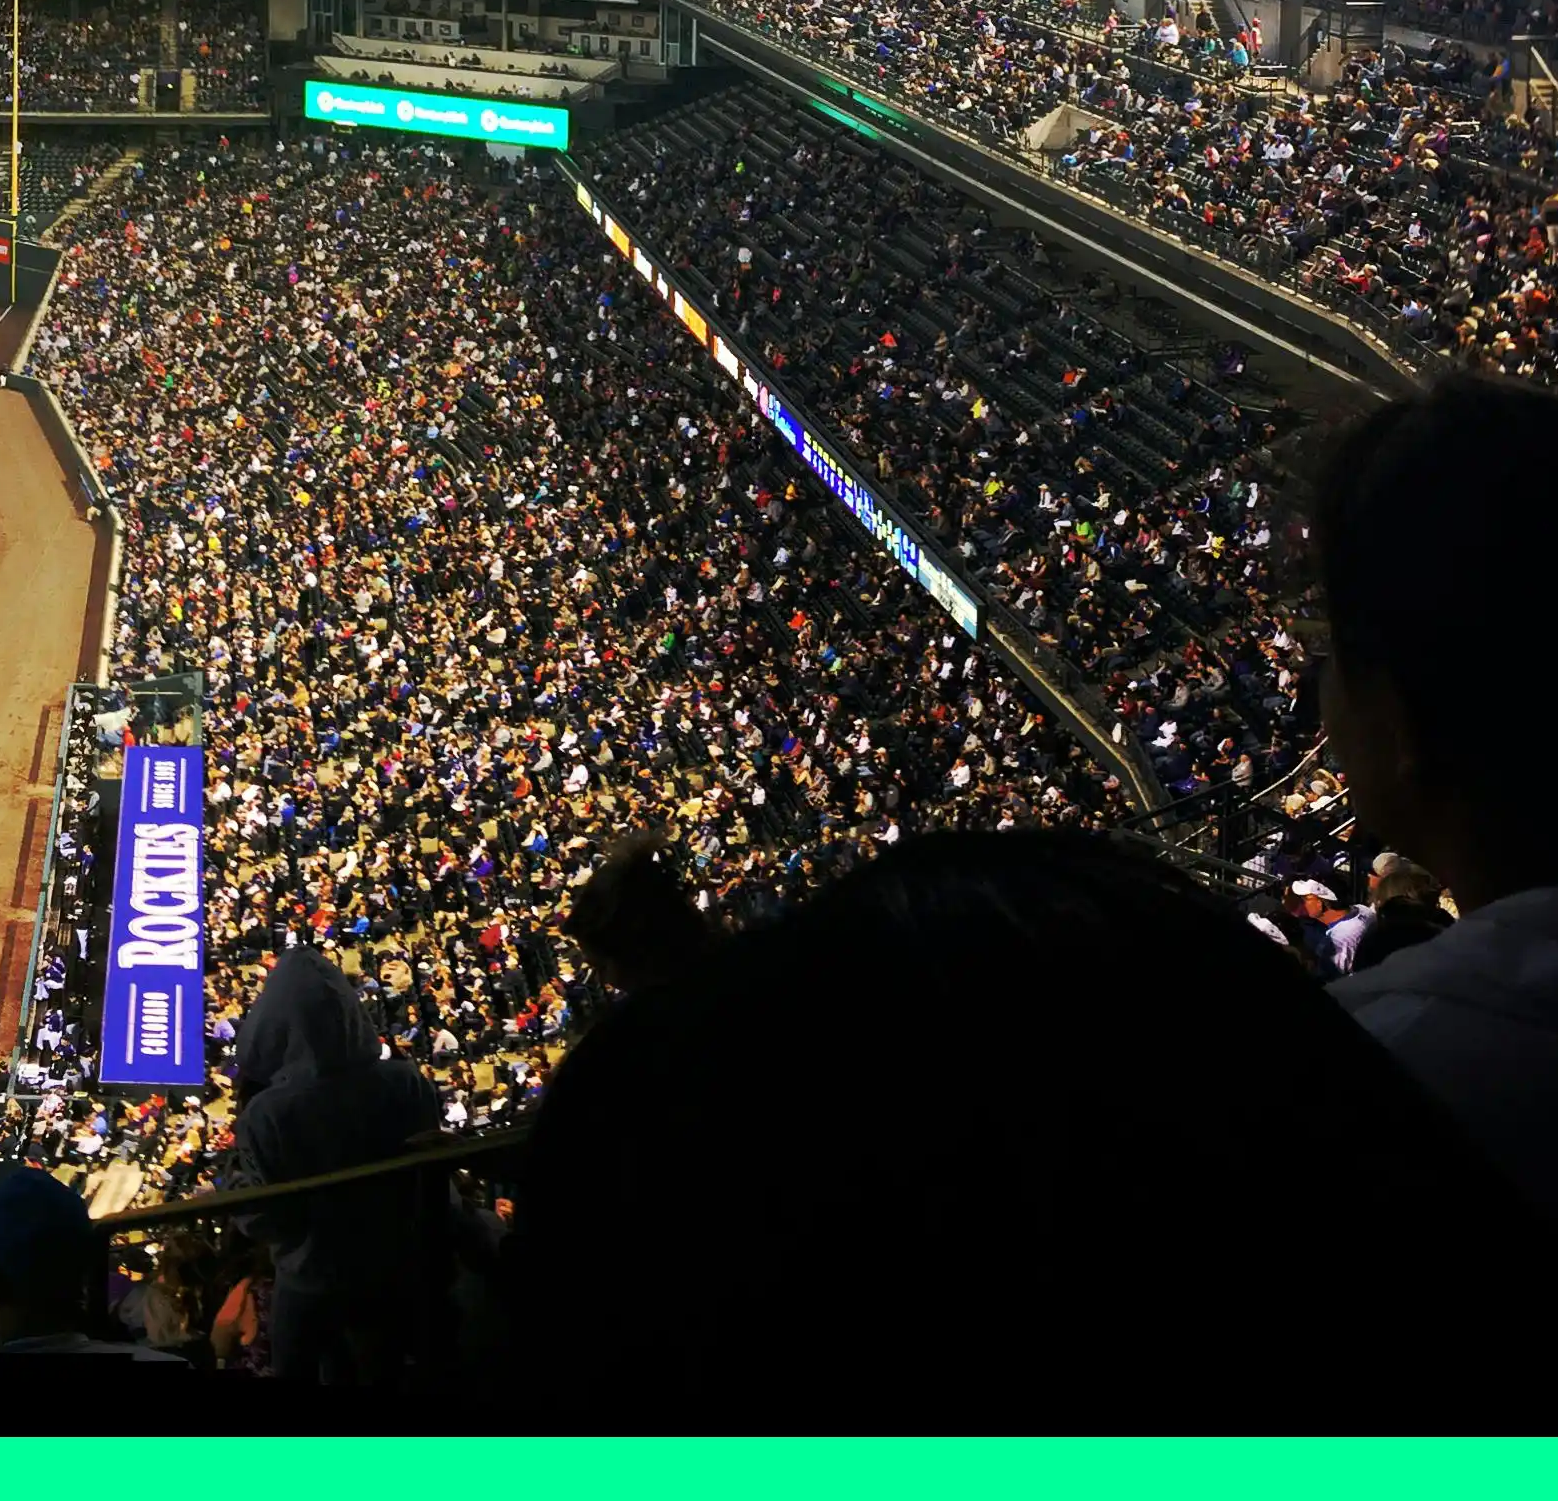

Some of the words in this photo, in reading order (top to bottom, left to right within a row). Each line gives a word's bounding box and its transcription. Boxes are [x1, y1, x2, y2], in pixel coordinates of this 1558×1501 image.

[154, 760, 176, 780] 1993
[152, 782, 175, 808] SINCE
[118, 823, 200, 970] ROCKIES
[140, 991, 170, 1056] COLORADO
